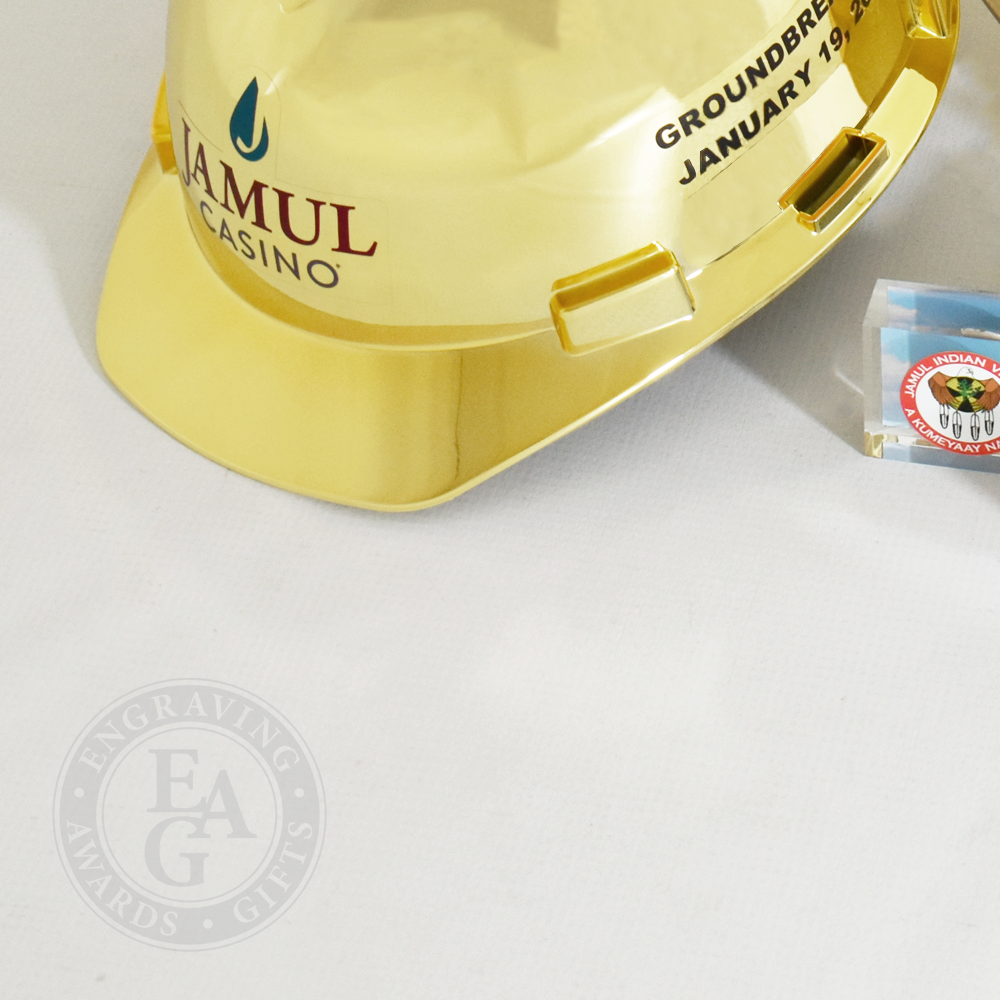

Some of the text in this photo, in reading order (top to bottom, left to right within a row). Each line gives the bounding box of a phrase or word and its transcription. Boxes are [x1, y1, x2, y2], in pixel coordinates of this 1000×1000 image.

[679, 58, 811, 185] JANUARY
[818, 25, 851, 63] 19,
[182, 117, 378, 257] JAMUL
[200, 200, 339, 289] CASINO
[904, 364, 932, 398] JAMUL
[932, 353, 987, 367] INDIAN
[904, 408, 914, 417] A
[912, 418, 981, 453] KUMEYAAY
